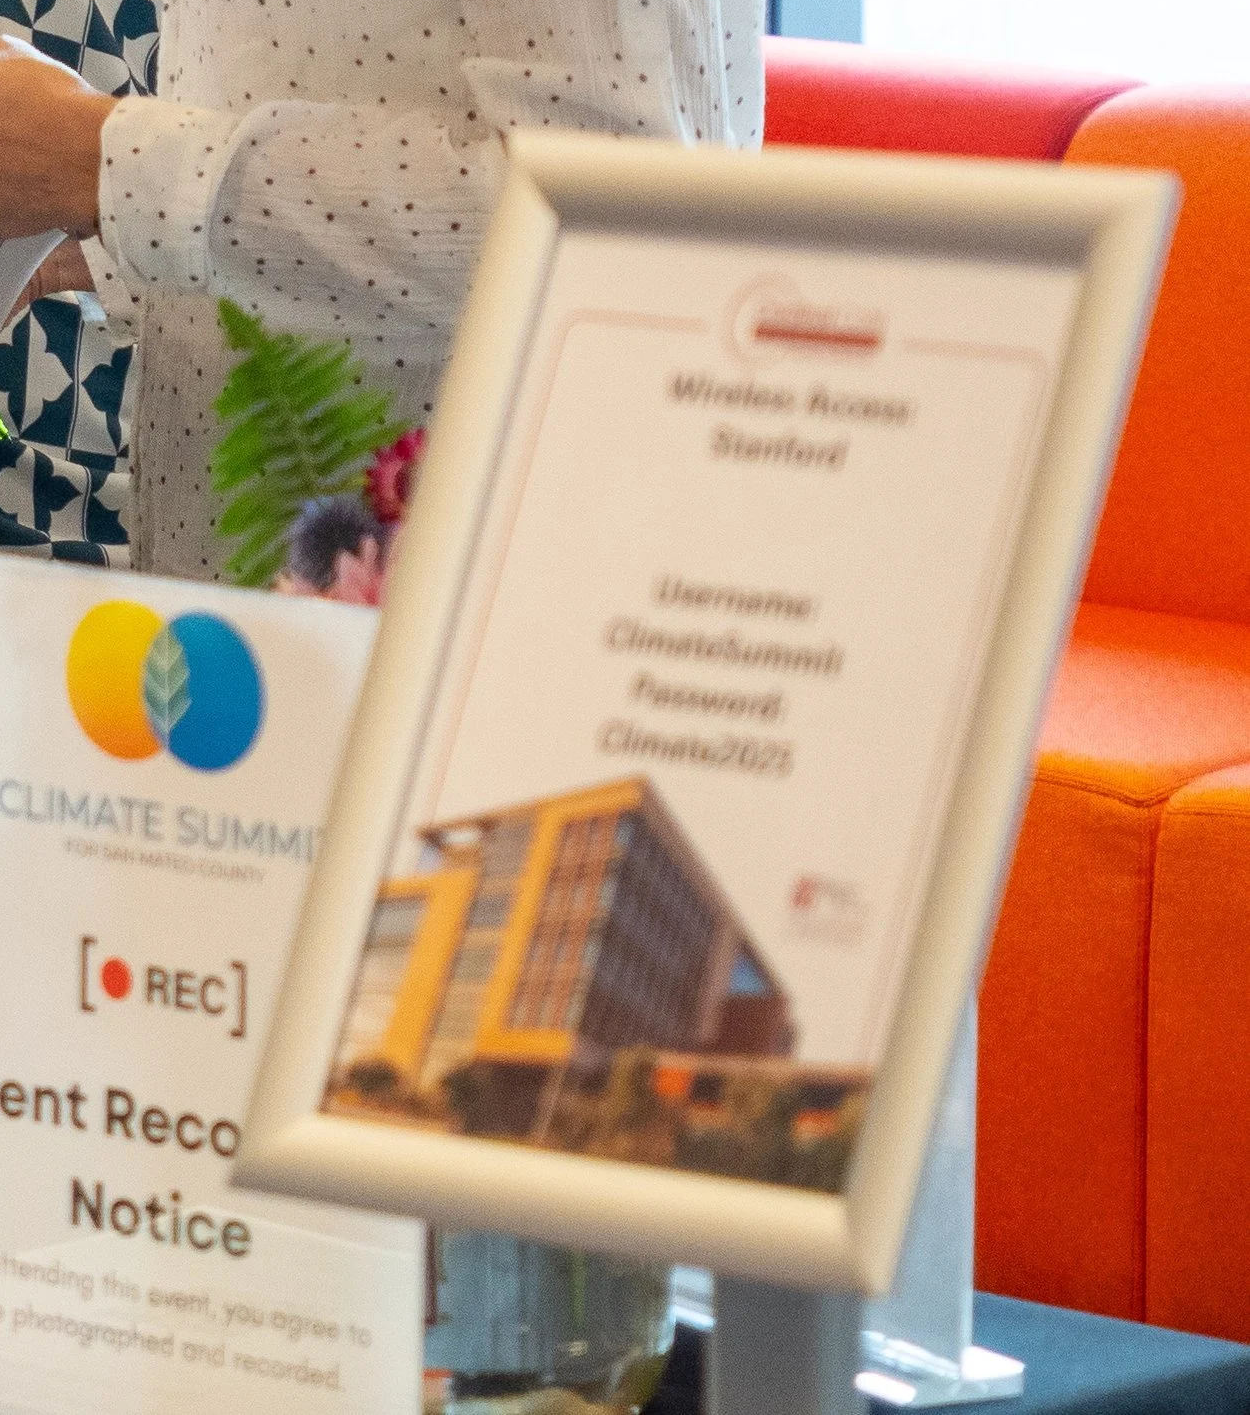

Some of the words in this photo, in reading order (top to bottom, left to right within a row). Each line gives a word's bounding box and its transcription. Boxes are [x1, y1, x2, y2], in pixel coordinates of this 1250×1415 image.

[669, 373, 796, 414] Wireless
[806, 382, 914, 426] Access
[710, 425, 849, 473] Stanford
[176, 804, 320, 864] SUMMI
[103, 1086, 241, 1160] Reco
[68, 1176, 252, 1258] Notice
[12, 1303, 175, 1359] photographed
[182, 1337, 225, 1369] and
[101, 1273, 141, 1302] this
[222, 1298, 264, 1327] you
[270, 1307, 340, 1342] agree
[349, 1317, 373, 1349] to
